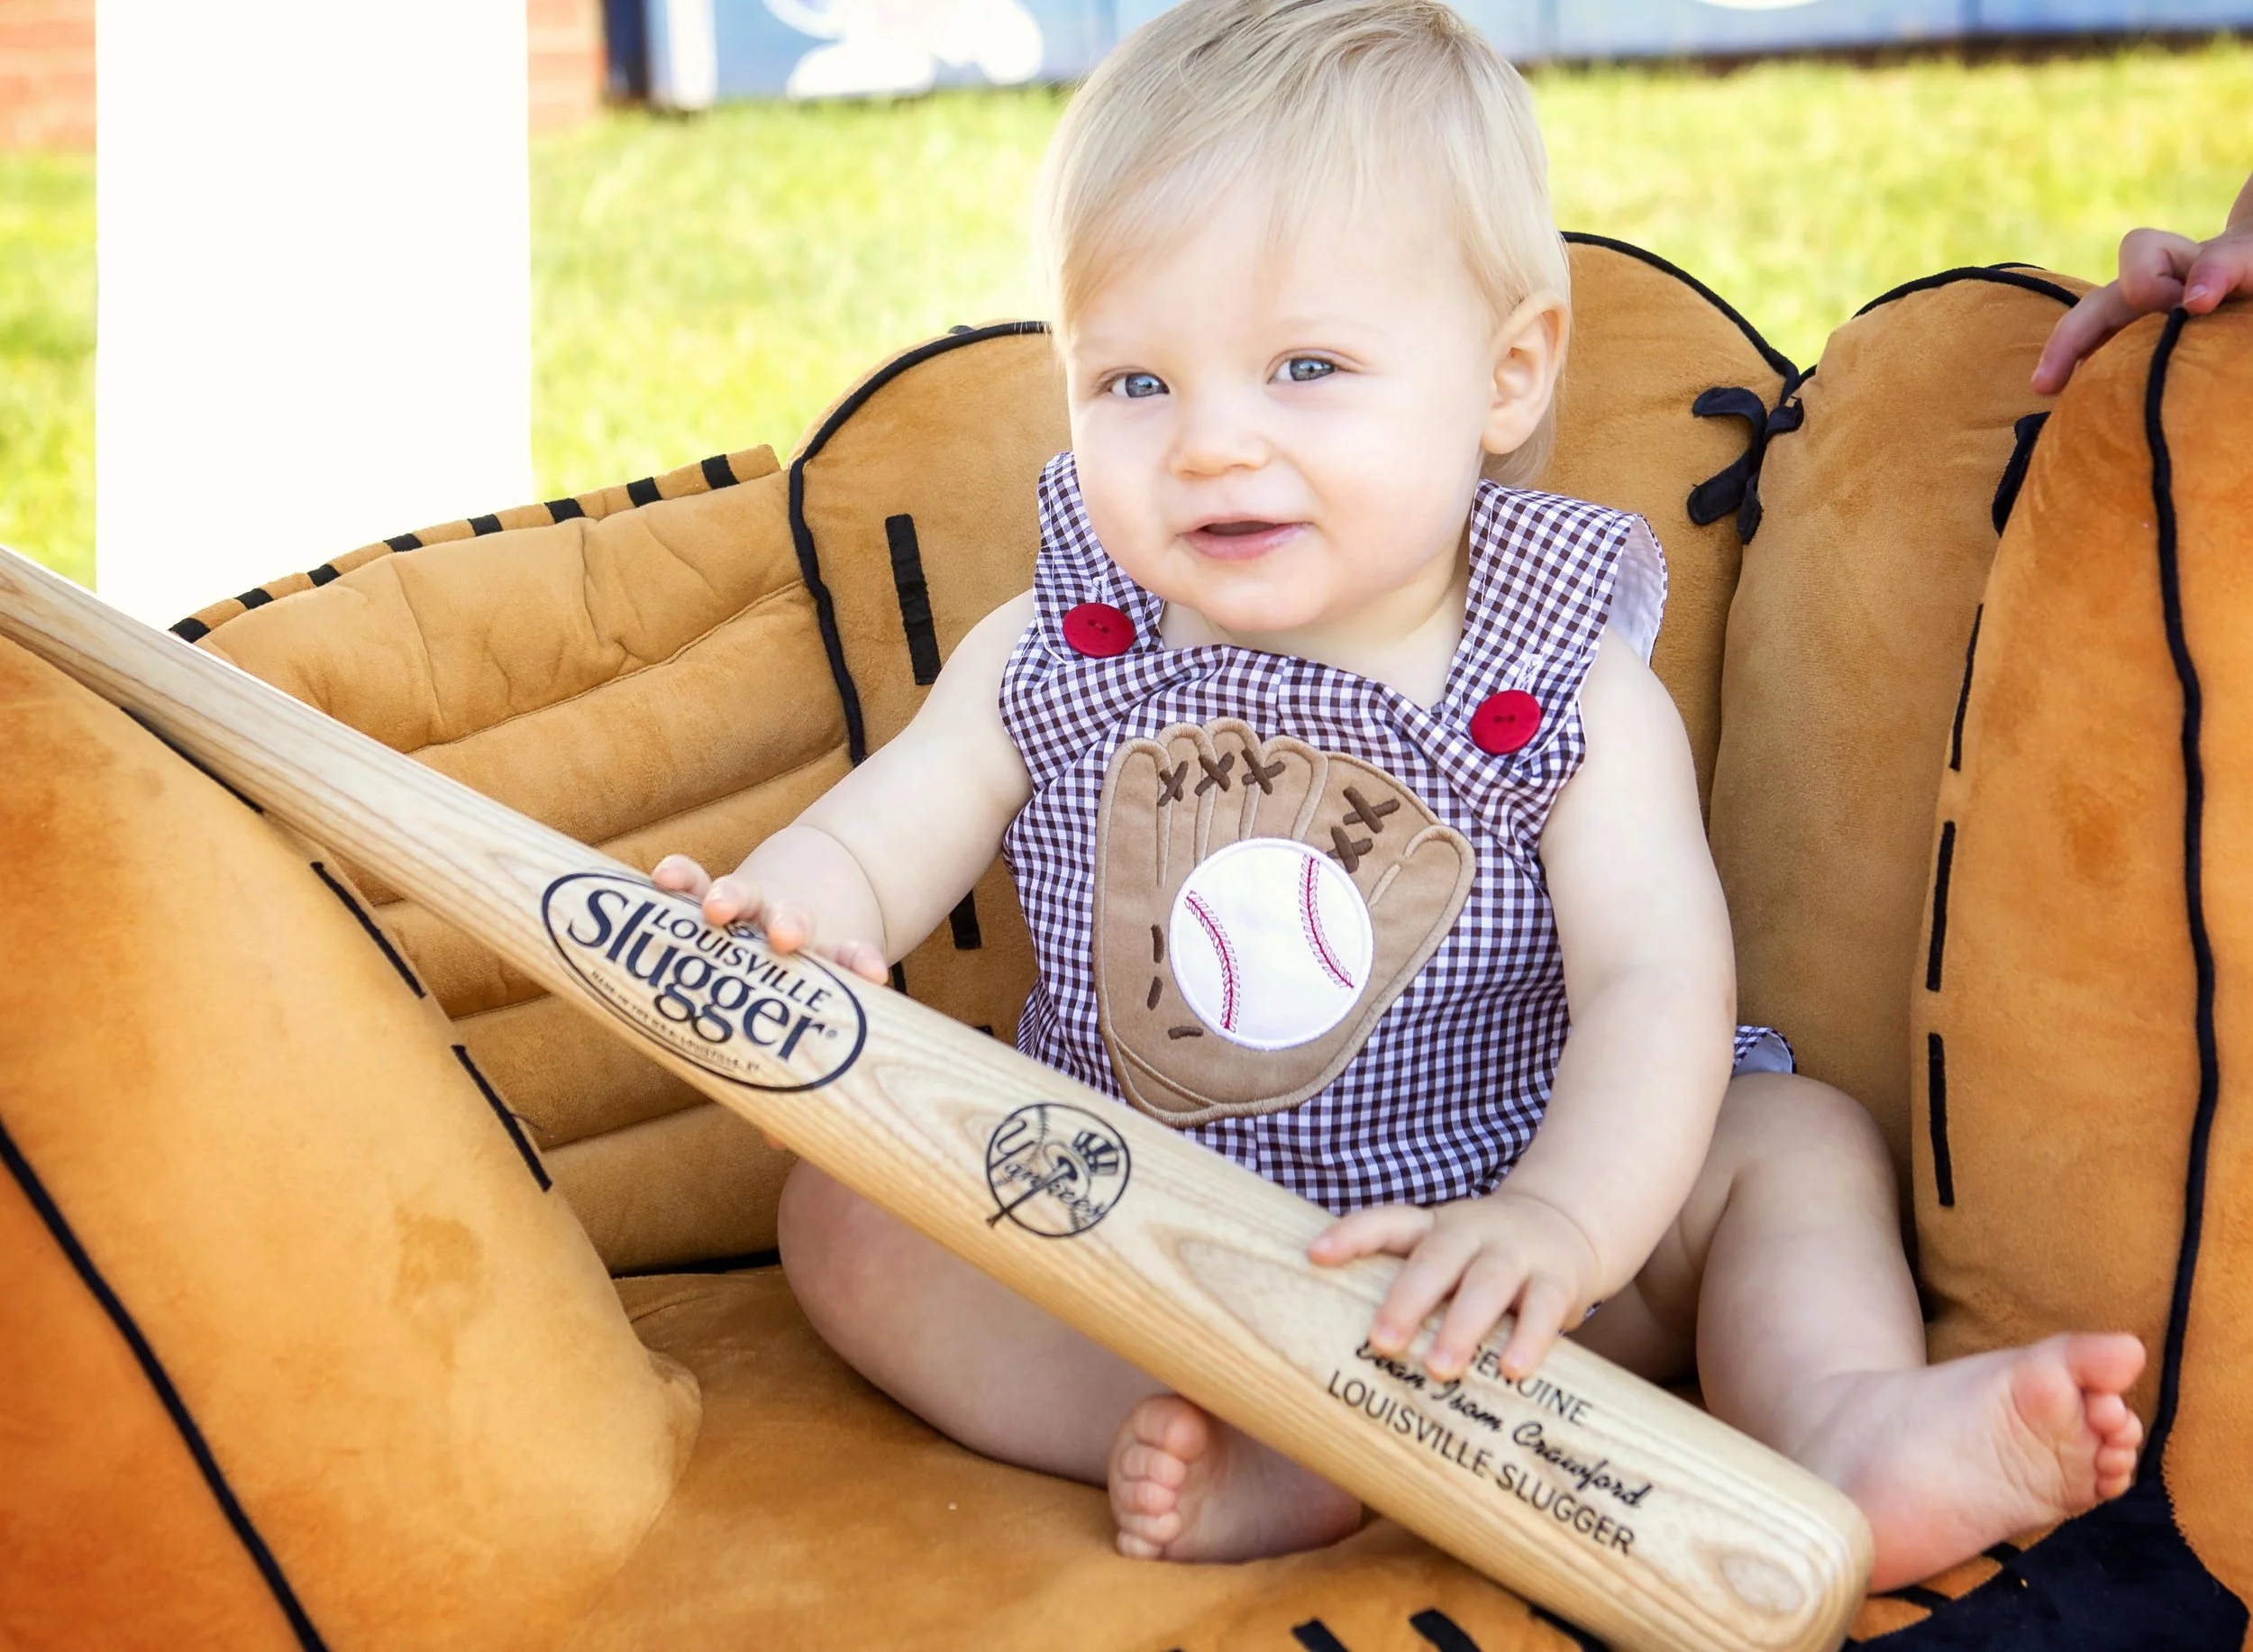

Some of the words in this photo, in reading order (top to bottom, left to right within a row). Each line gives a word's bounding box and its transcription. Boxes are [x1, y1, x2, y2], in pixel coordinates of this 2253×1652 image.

[652, 907, 833, 1013] LOUISVILLE
[1327, 1369, 1494, 1479] LOUISVILLE
[1496, 1463, 1636, 1556] SLUGGER
[1512, 1420, 1653, 1509] Crawford
